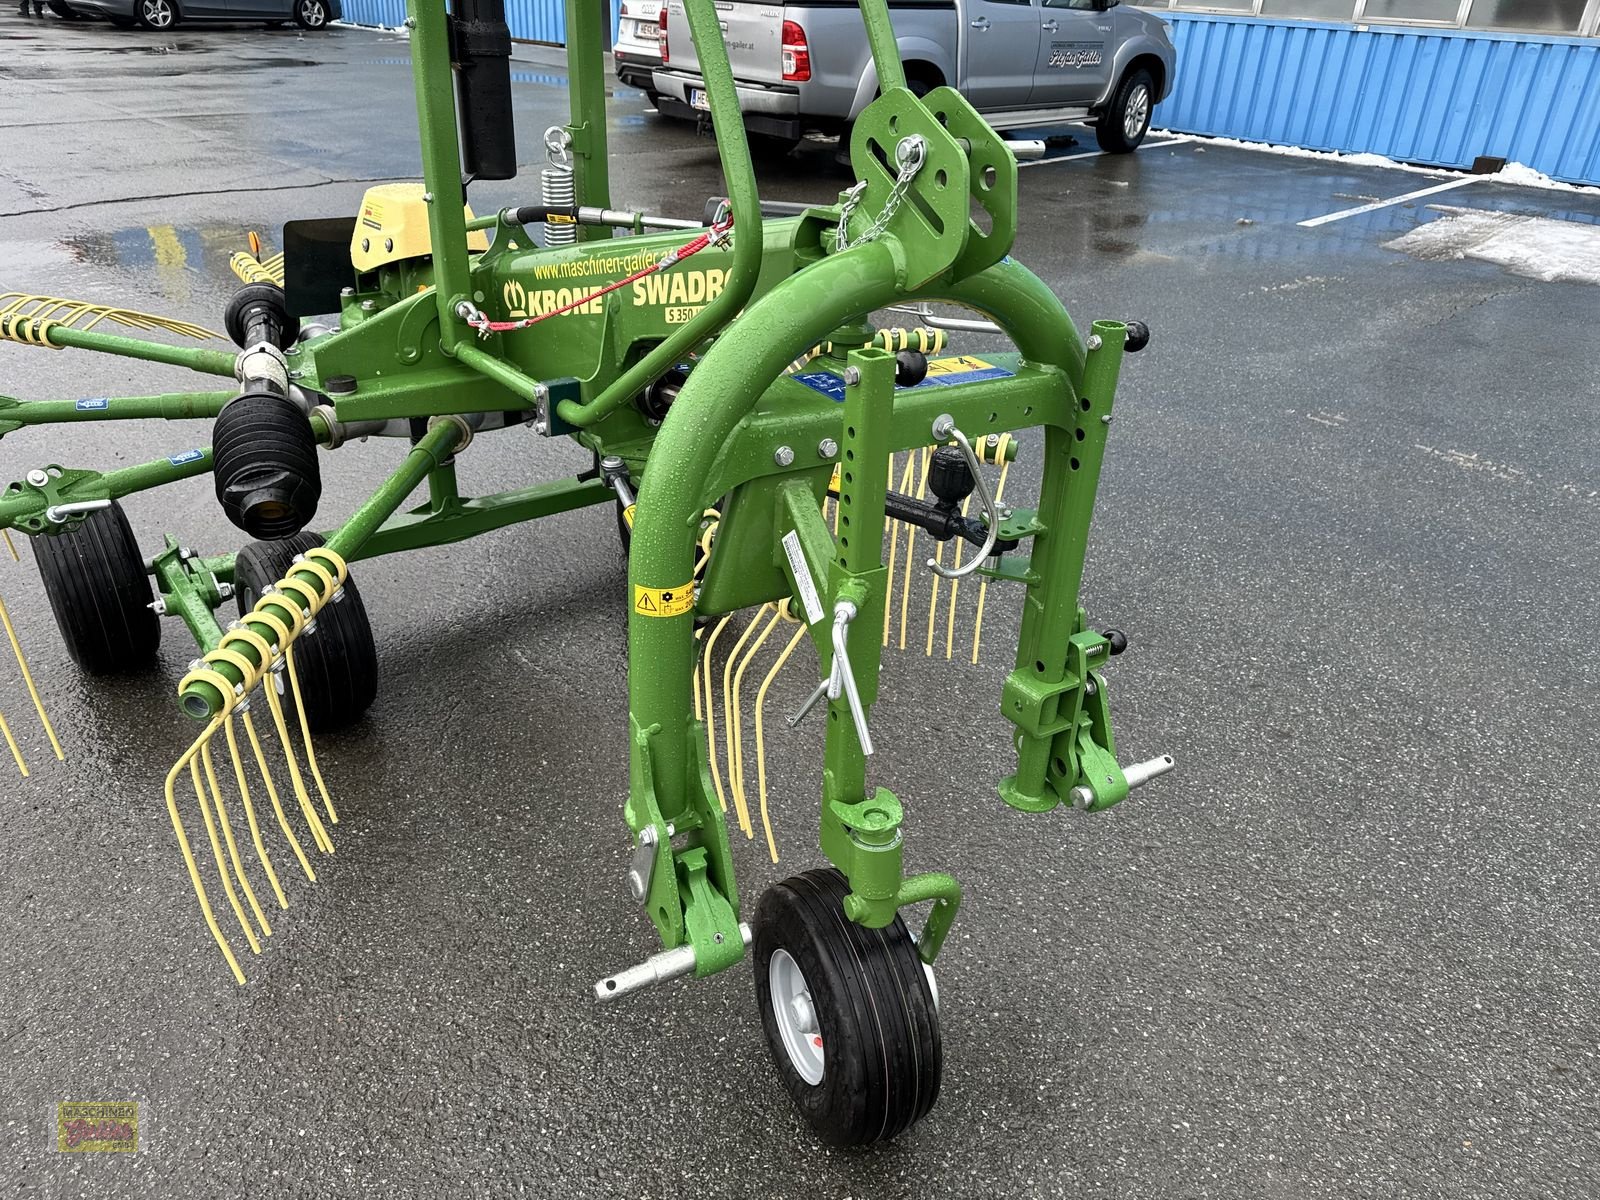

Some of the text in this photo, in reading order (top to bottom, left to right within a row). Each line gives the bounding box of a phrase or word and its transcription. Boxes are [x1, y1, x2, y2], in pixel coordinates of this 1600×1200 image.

[528, 286, 603, 317] KRONE
[669, 309, 675, 322] S
[676, 308, 694, 322] 350
